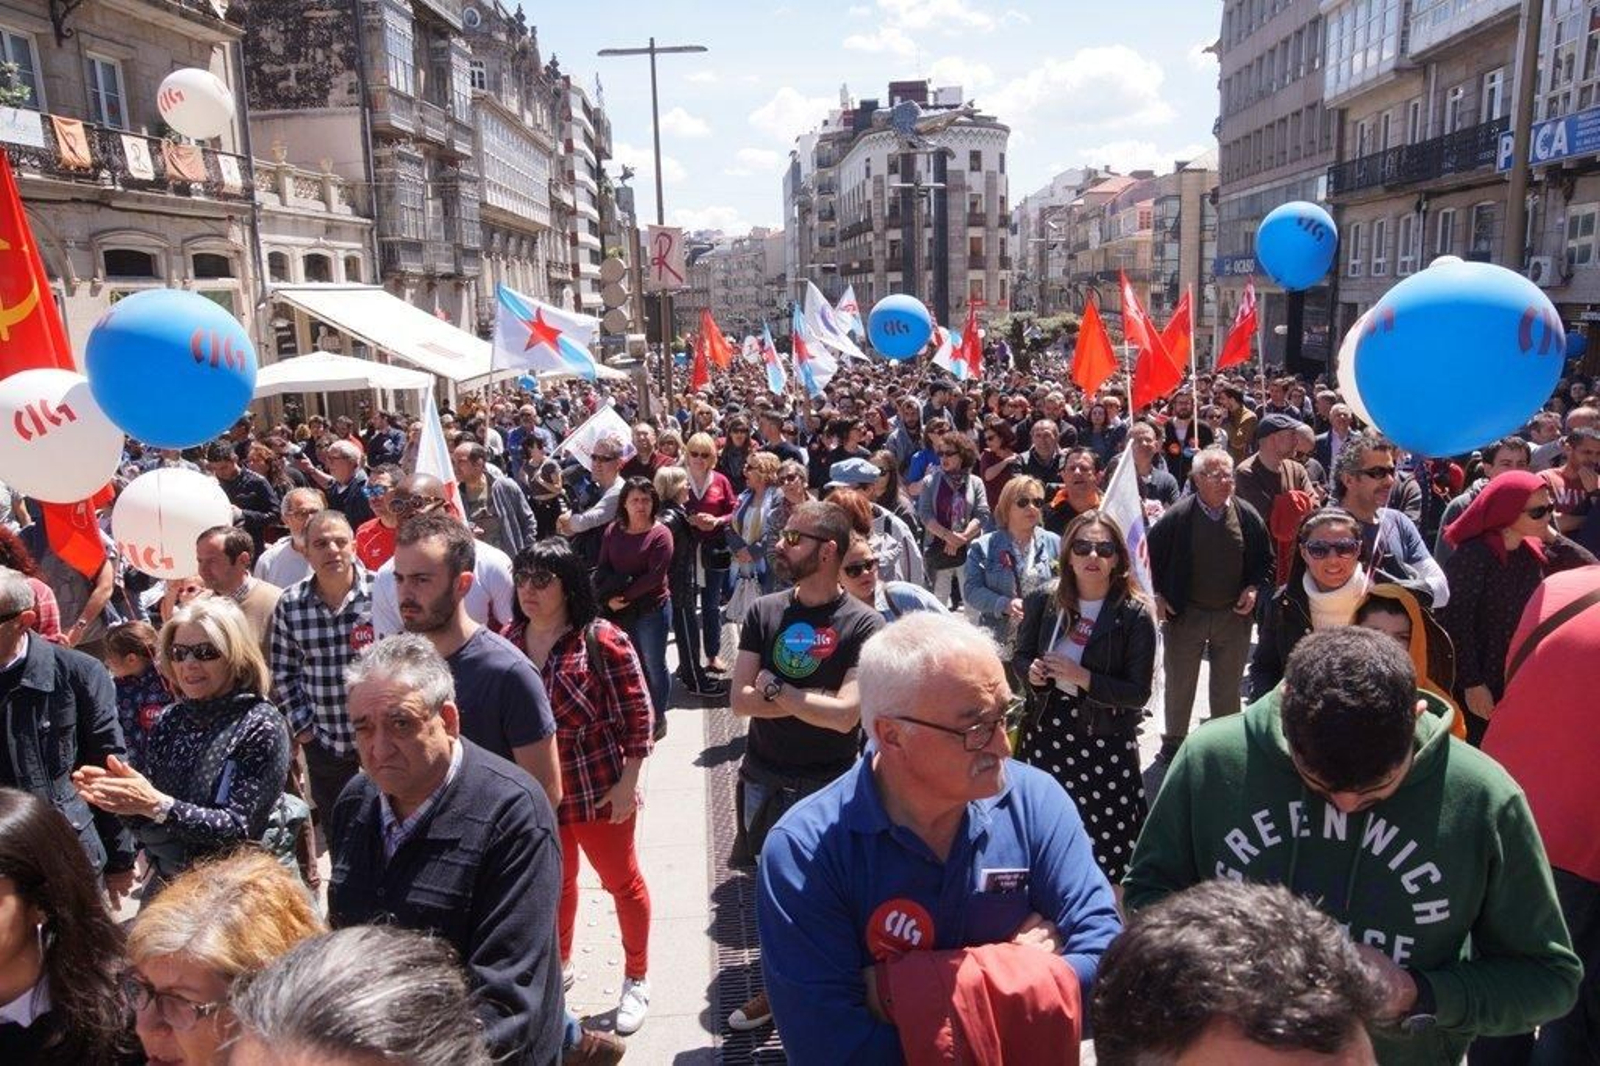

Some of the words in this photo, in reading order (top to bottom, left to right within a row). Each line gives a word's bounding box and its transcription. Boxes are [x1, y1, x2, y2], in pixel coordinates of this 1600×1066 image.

[190, 325, 247, 372] CIG
[884, 319, 909, 337] CIG
[14, 398, 77, 442] CIG
[1214, 800, 1451, 925] GREENWICH
[884, 909, 923, 947] CIG
